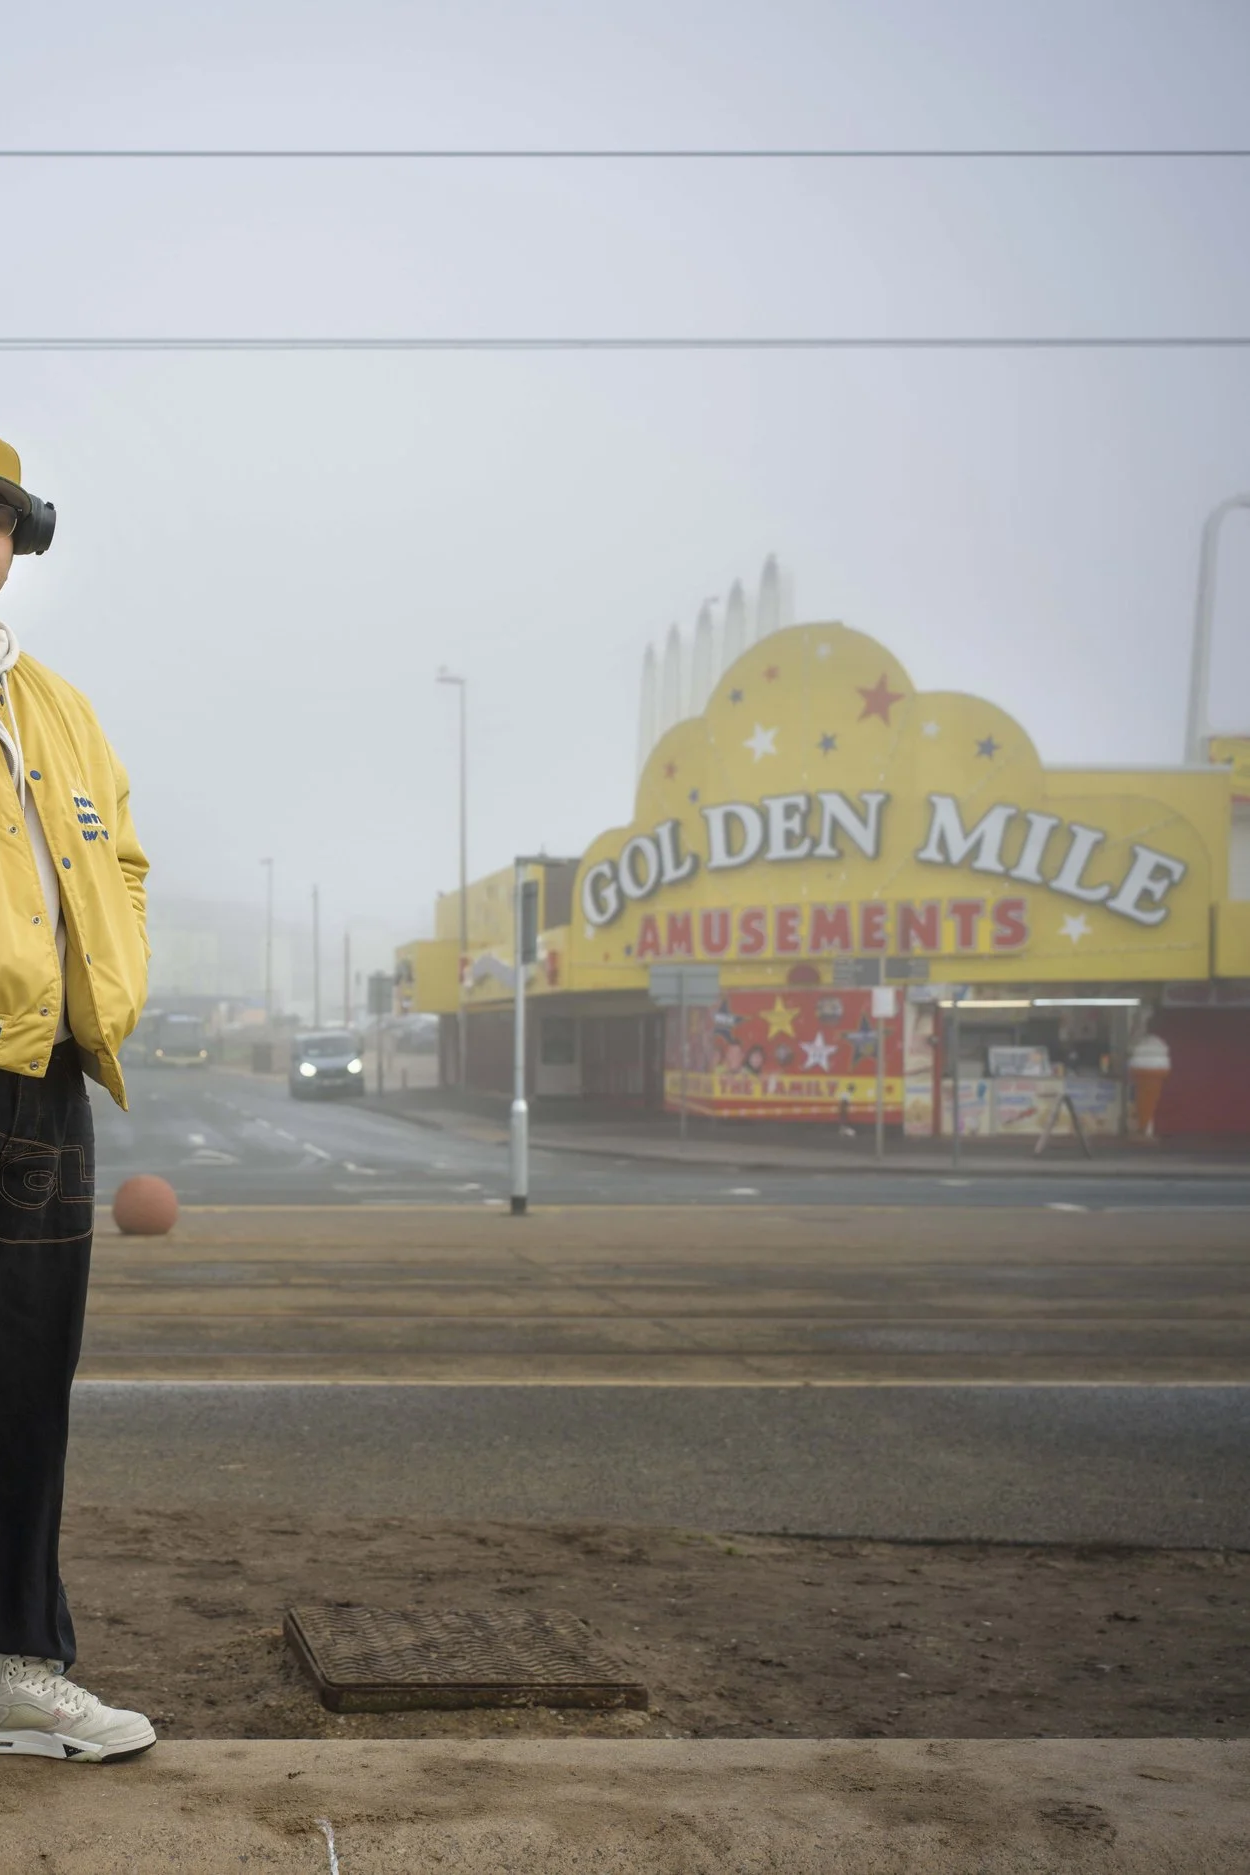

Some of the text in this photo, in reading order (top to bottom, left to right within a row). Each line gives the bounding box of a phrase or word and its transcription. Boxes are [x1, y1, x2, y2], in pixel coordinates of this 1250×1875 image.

[580, 790, 1188, 929] GOLDEN MILE
[636, 899, 1031, 960] AMUSEMENTS
